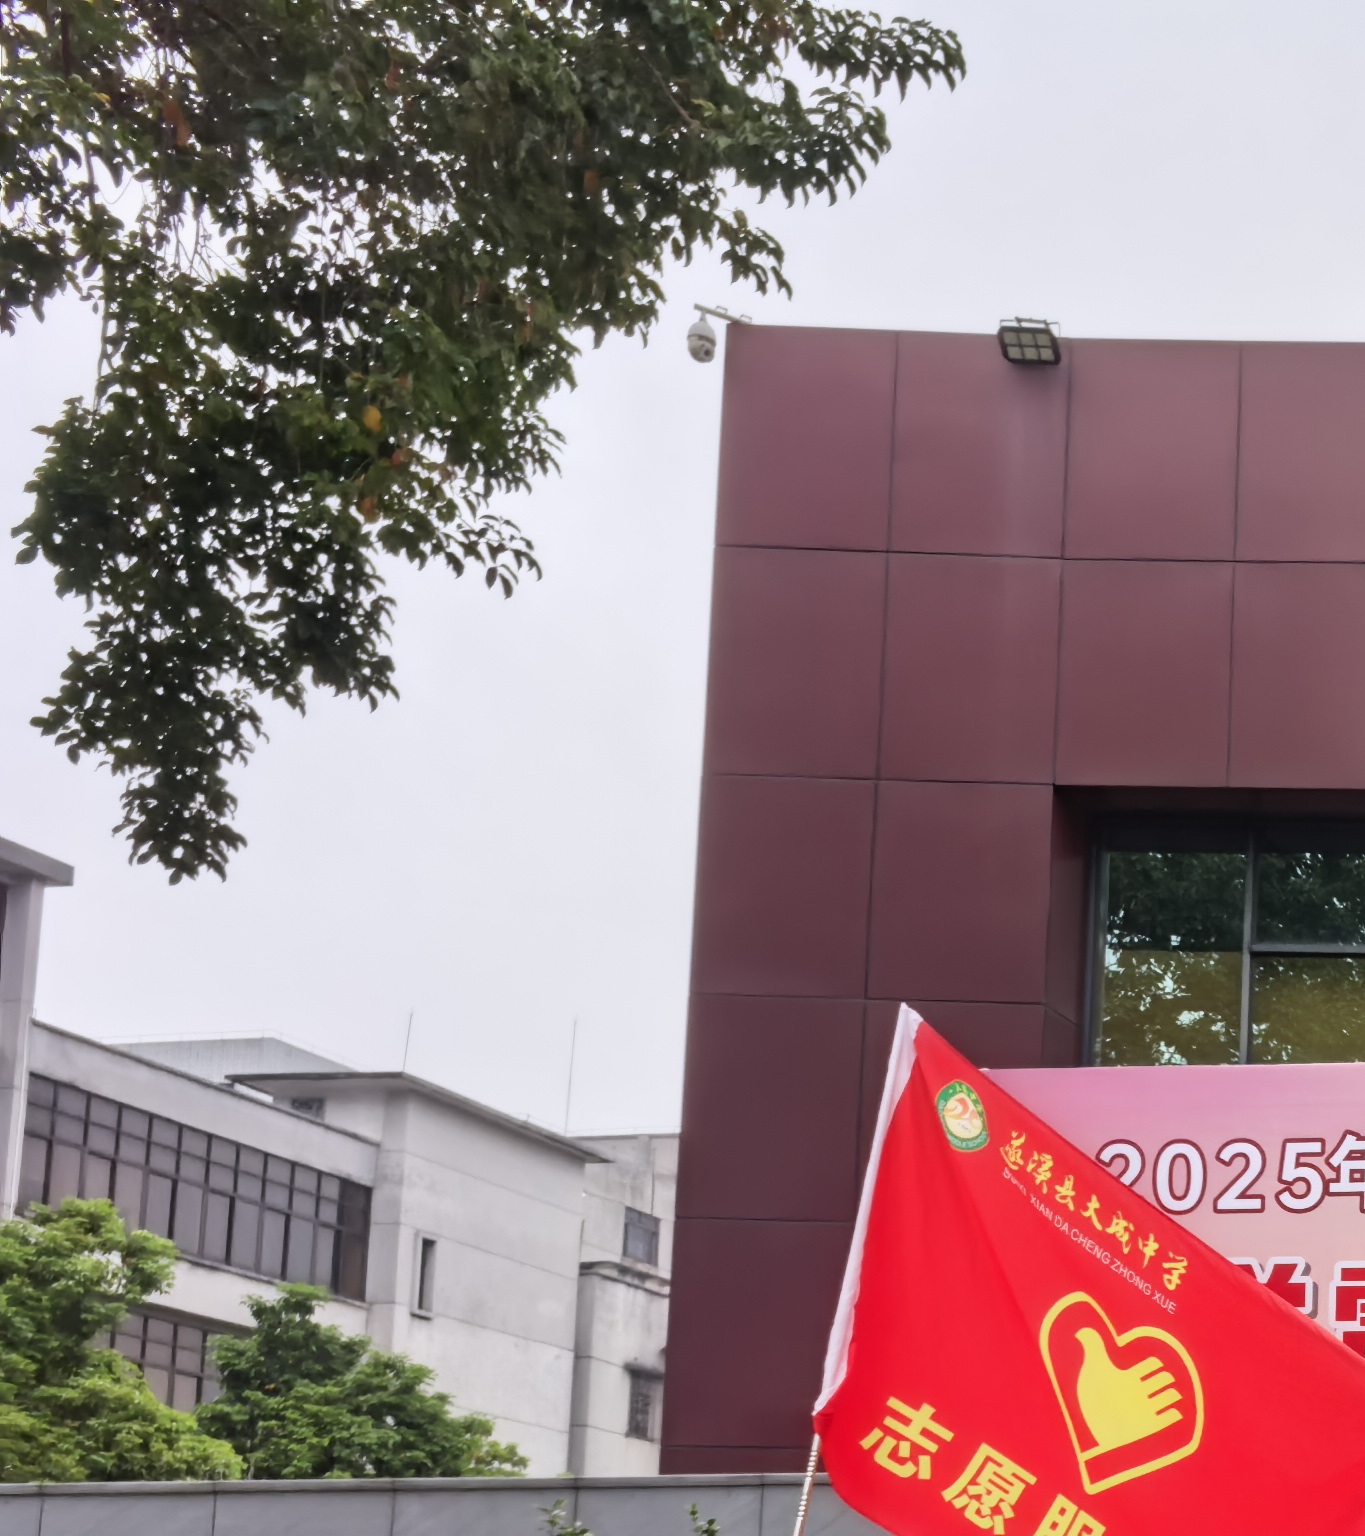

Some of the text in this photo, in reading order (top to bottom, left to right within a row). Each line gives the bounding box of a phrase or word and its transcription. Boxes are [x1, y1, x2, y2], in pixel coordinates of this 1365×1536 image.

[1030, 1194, 1177, 1315] XIAN DA CHENG ZHONG XUE
